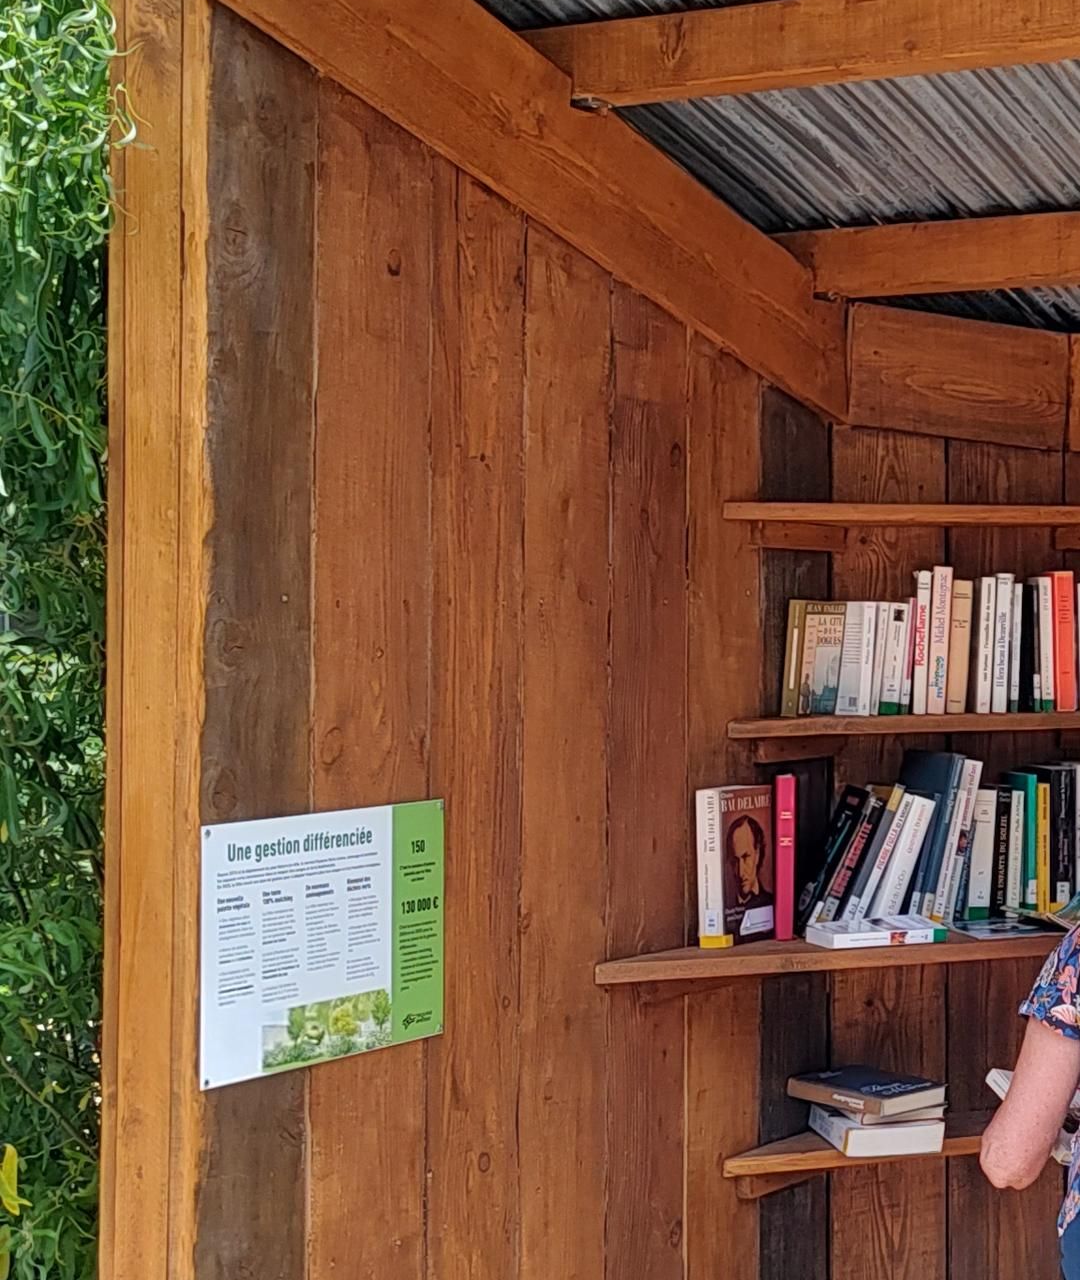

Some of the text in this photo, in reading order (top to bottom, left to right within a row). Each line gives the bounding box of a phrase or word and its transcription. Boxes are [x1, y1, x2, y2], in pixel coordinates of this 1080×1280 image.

[721, 795, 771, 812] BAUDELAIRE
[228, 826, 373, 863] Une gestion différenciée
[411, 839, 425, 854] 150
[401, 895, 439, 914] 130 000 €
